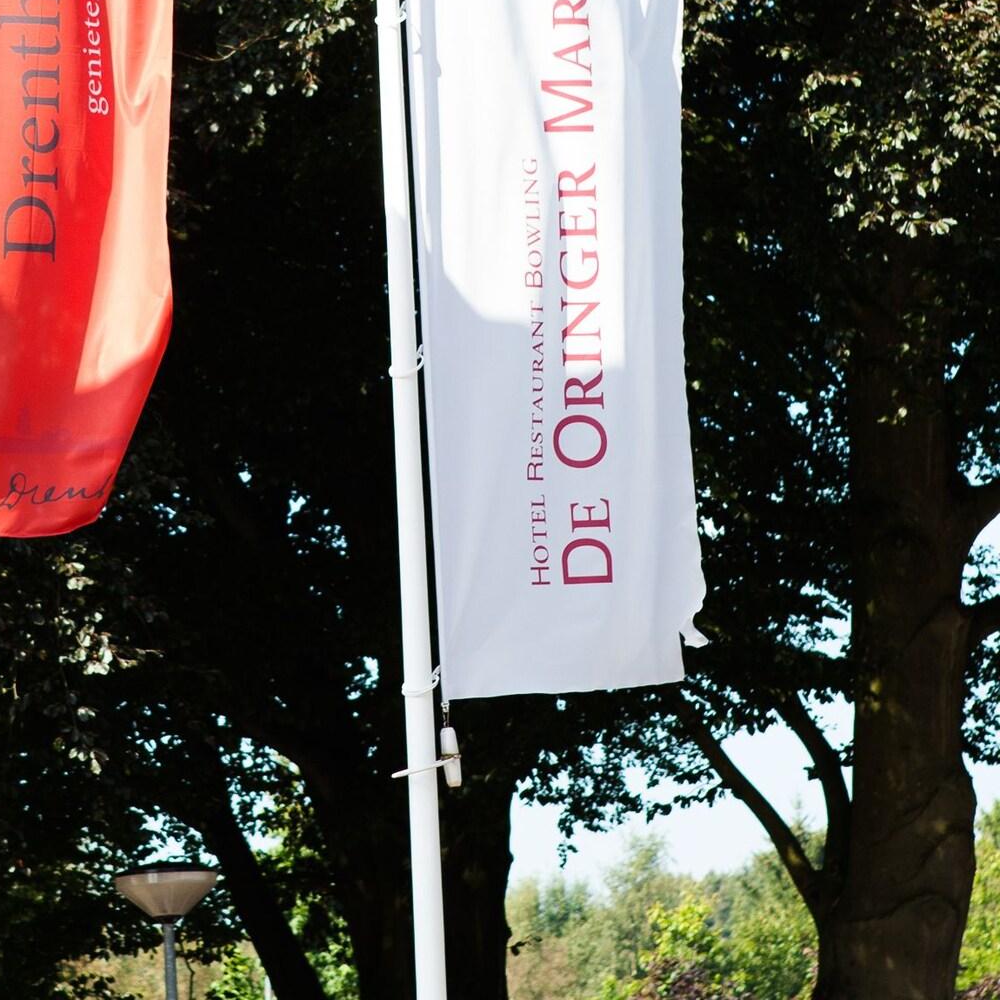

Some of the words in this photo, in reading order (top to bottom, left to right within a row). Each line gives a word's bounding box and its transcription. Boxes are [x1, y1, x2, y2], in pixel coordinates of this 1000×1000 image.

[526, 299, 545, 482] RESTAURANT
[552, 162, 608, 469] ORINGER
[530, 494, 551, 586] HOTEL
